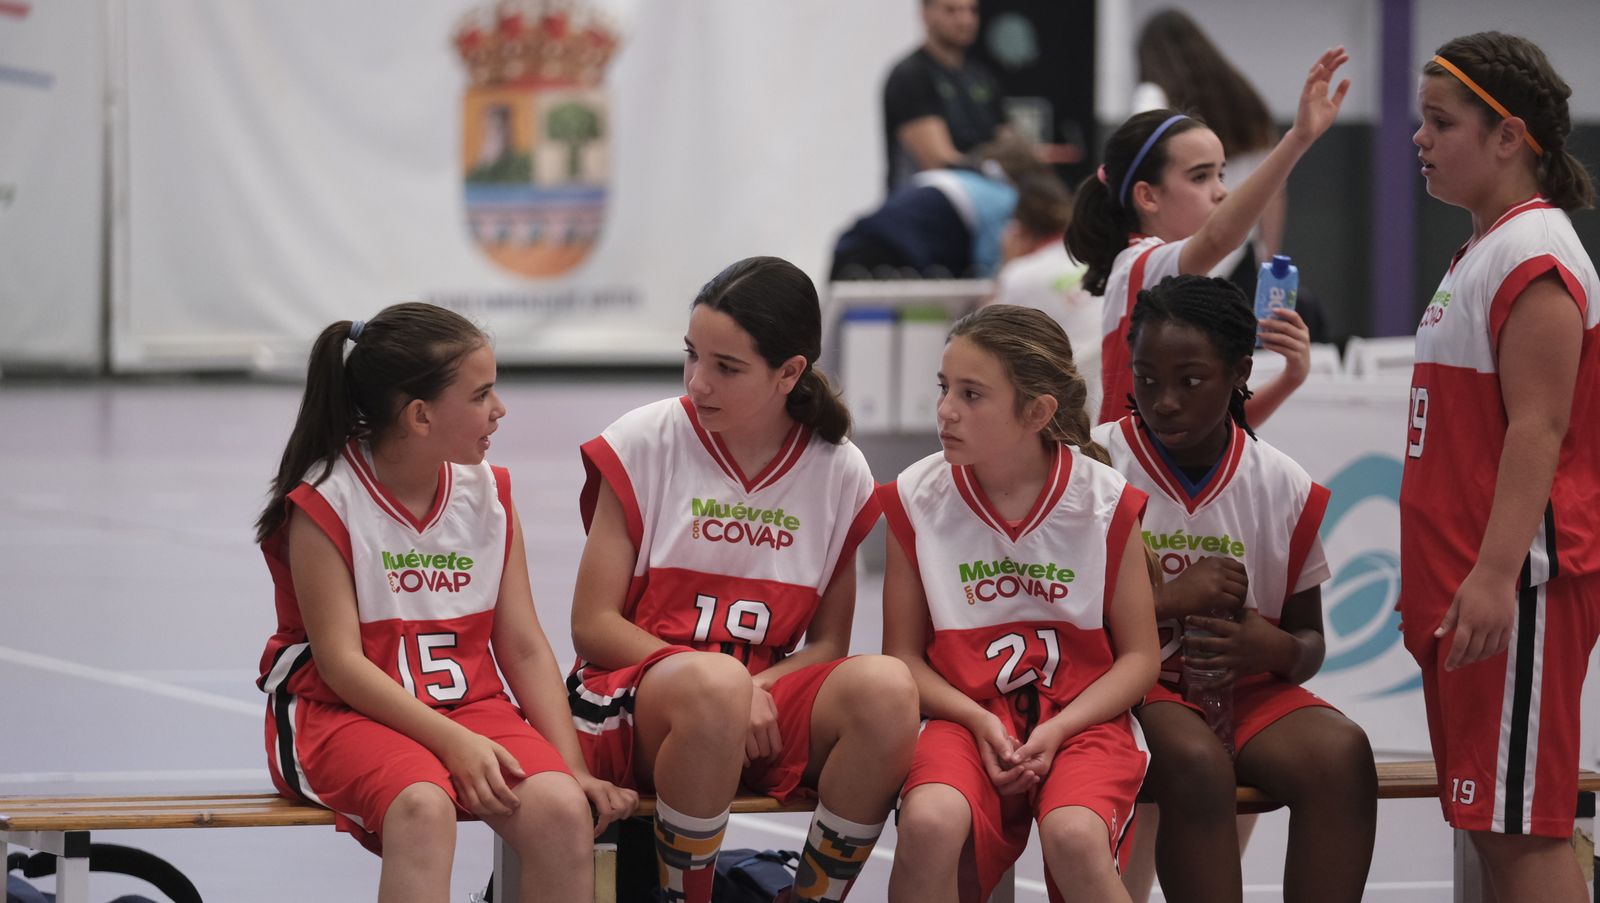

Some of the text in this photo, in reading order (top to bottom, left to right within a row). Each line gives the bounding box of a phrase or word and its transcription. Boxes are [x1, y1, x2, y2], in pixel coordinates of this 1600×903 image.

[691, 497, 801, 531] Muévete
[692, 517, 700, 540] con
[702, 518, 794, 551] COVAP
[958, 556, 1076, 583] Muévete
[964, 585, 975, 606] con
[975, 575, 1069, 604] COVAP
[692, 592, 773, 645] 19
[397, 631, 469, 702] 15
[985, 627, 1061, 695] 21
[1451, 777, 1476, 805] 19
